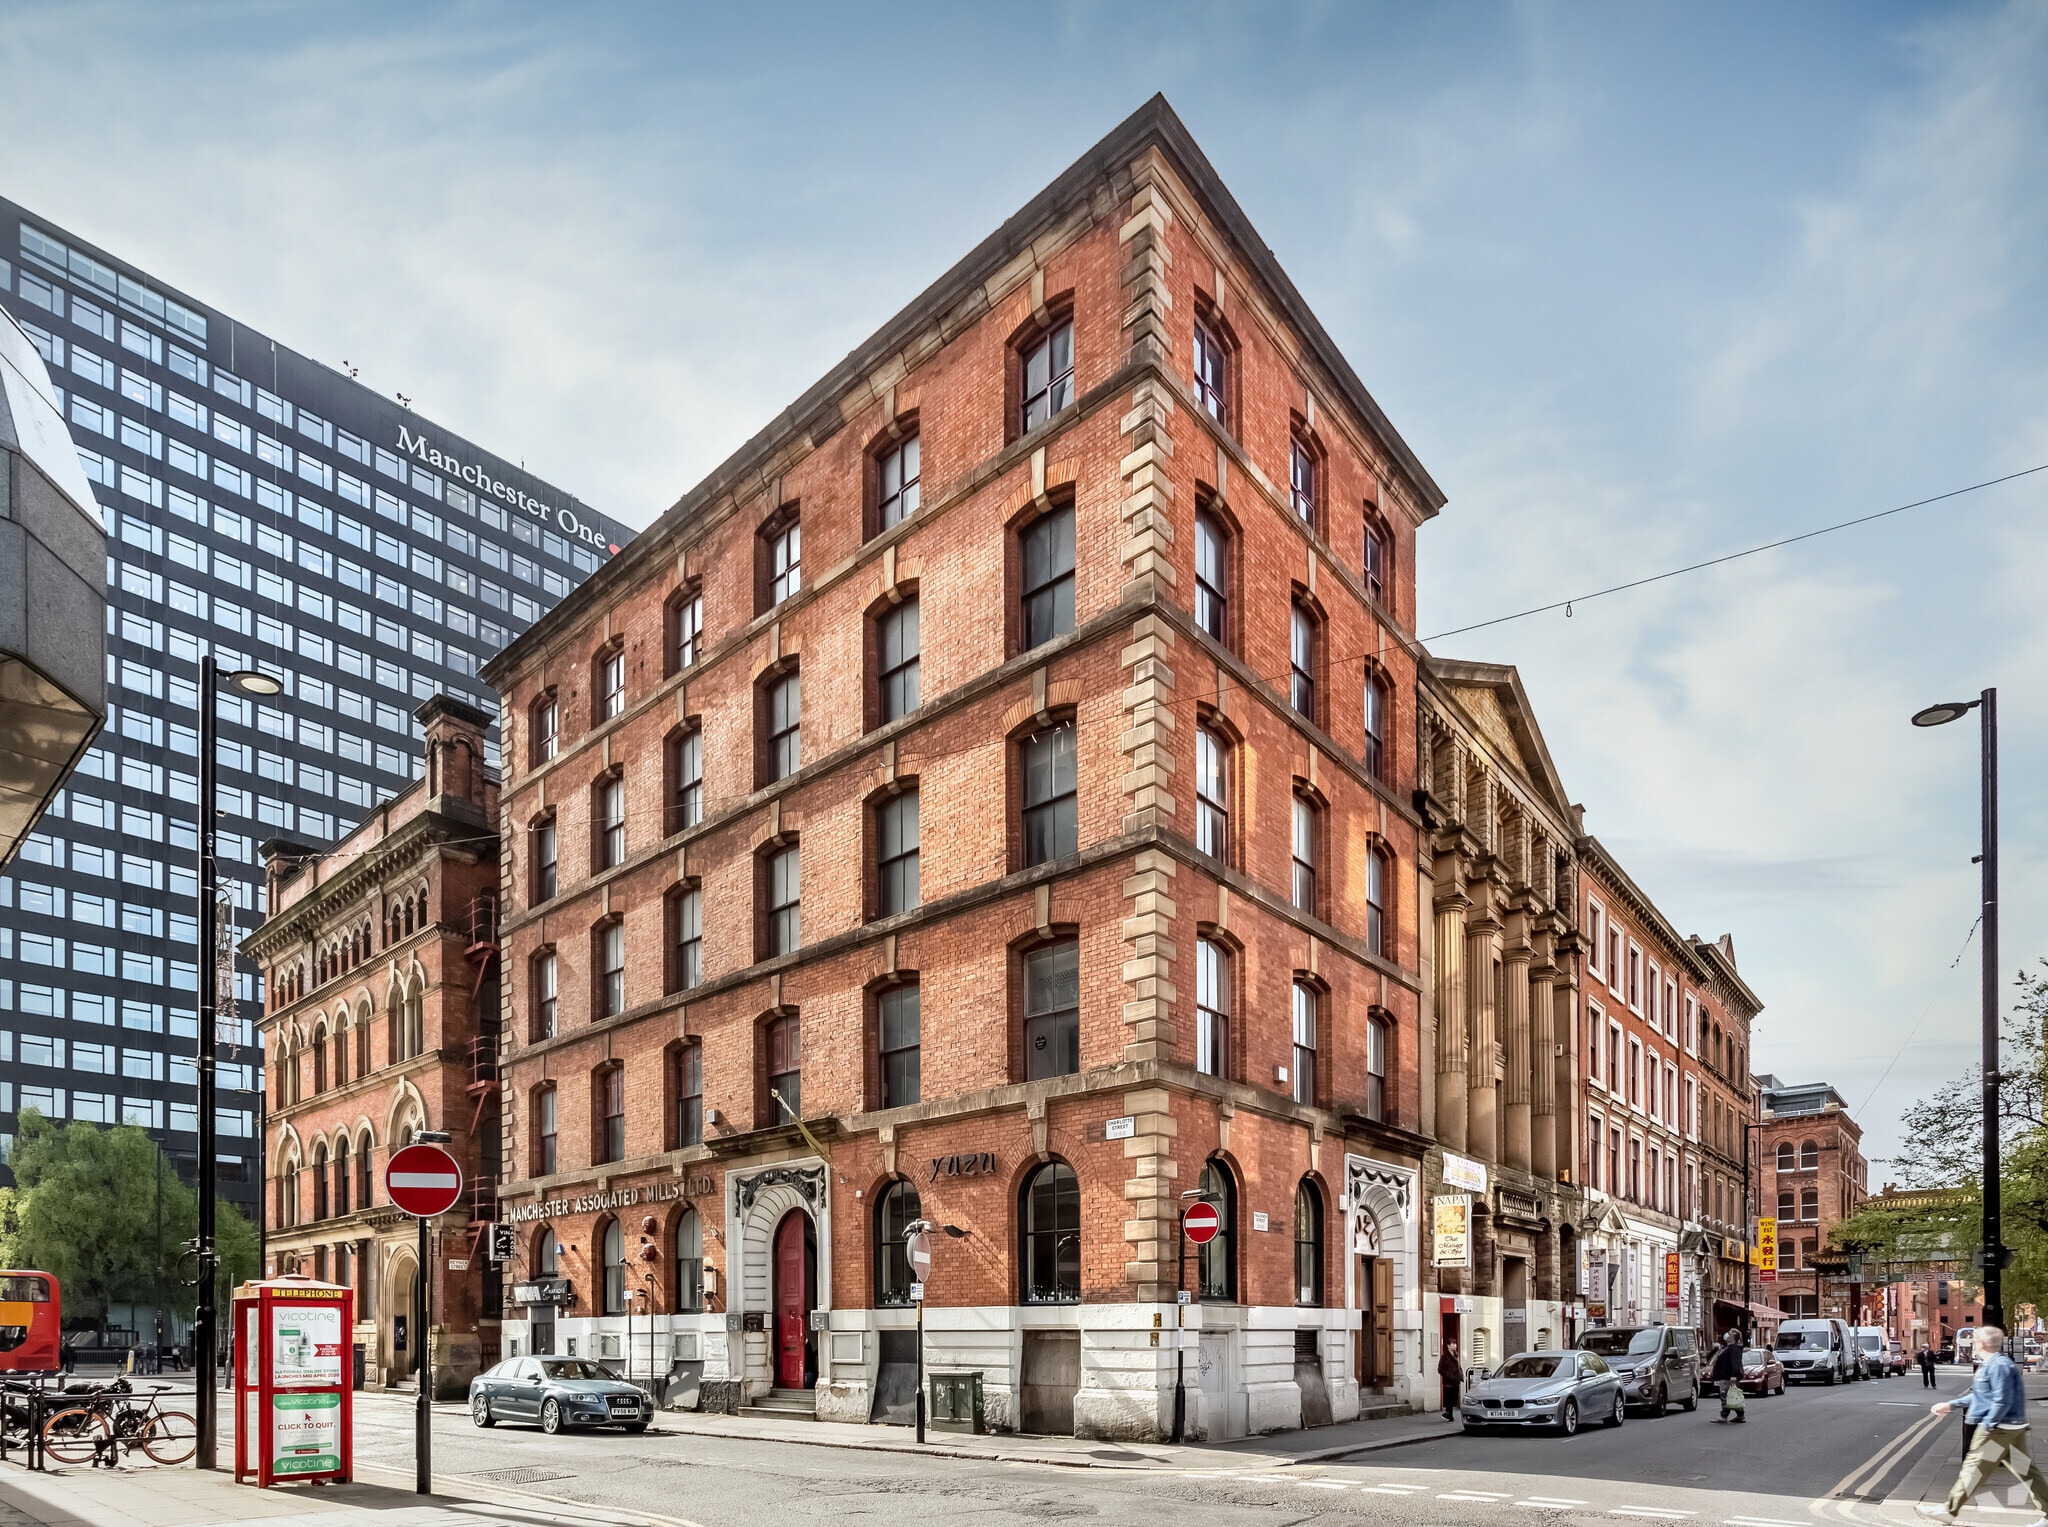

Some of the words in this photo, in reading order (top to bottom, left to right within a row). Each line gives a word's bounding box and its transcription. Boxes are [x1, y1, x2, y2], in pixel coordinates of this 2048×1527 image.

[396, 424, 550, 521] Manchester
[557, 509, 606, 550] One
[509, 1198, 569, 1223] MANCHESTER
[574, 1188, 638, 1213] ASSOCIATED
[646, 1182, 679, 1202] MILLS
[1437, 1196, 1465, 1205] NAPA
[1762, 1235, 1774, 1266] 永發行
[279, 1289, 339, 1298] TELEPHONE
[279, 1311, 335, 1322] vicotine
[729, 1320, 738, 1330] 34
[281, 1458, 334, 1469] vicotine
